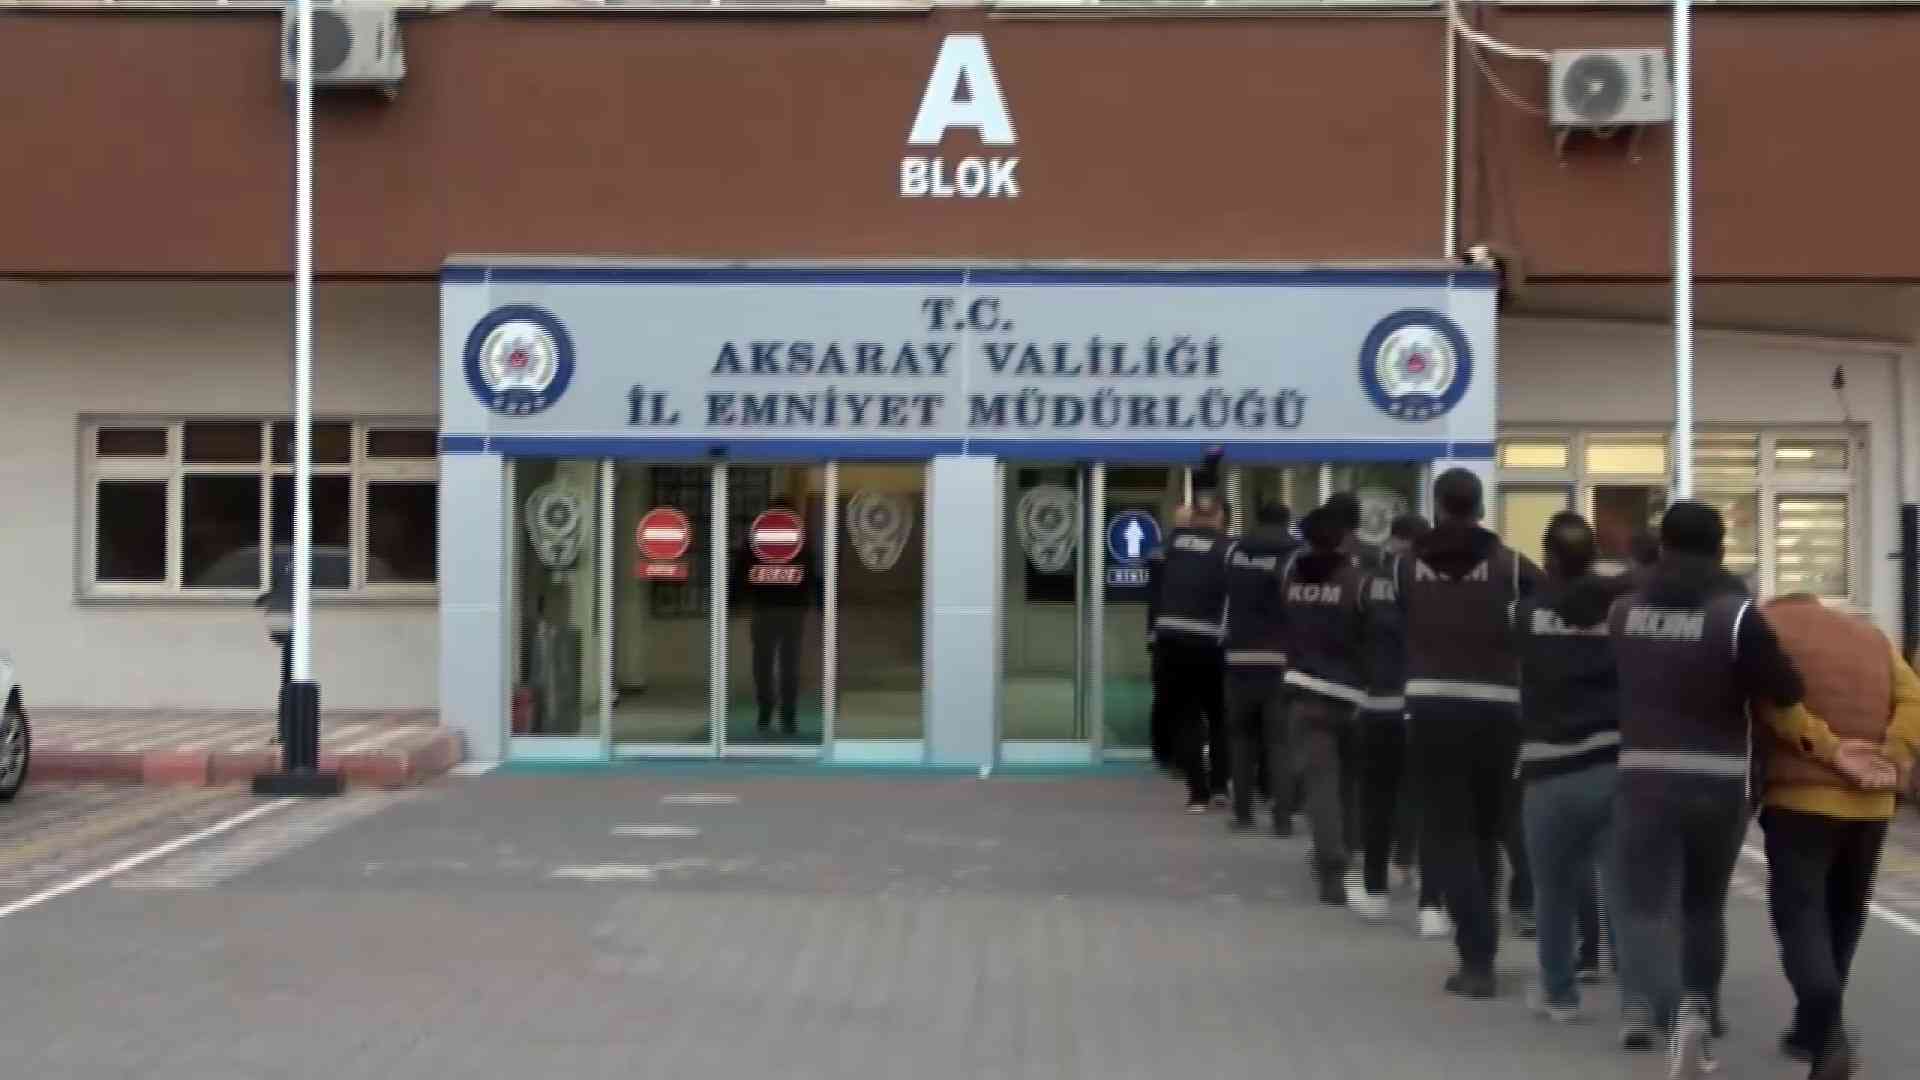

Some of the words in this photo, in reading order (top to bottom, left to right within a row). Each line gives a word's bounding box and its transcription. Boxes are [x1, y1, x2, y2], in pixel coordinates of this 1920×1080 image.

[907, 34, 1017, 145] A
[900, 157, 1020, 197] BLOK
[921, 298, 1013, 332] T.C.
[711, 341, 953, 377] AKSARAY
[983, 334, 1221, 377] VALİLİĞİ
[626, 384, 680, 427] İL
[705, 384, 944, 428] EMNİYET
[968, 387, 1308, 430] MÜDÜRLÜĞÜ
[1287, 583, 1342, 604] KOM
